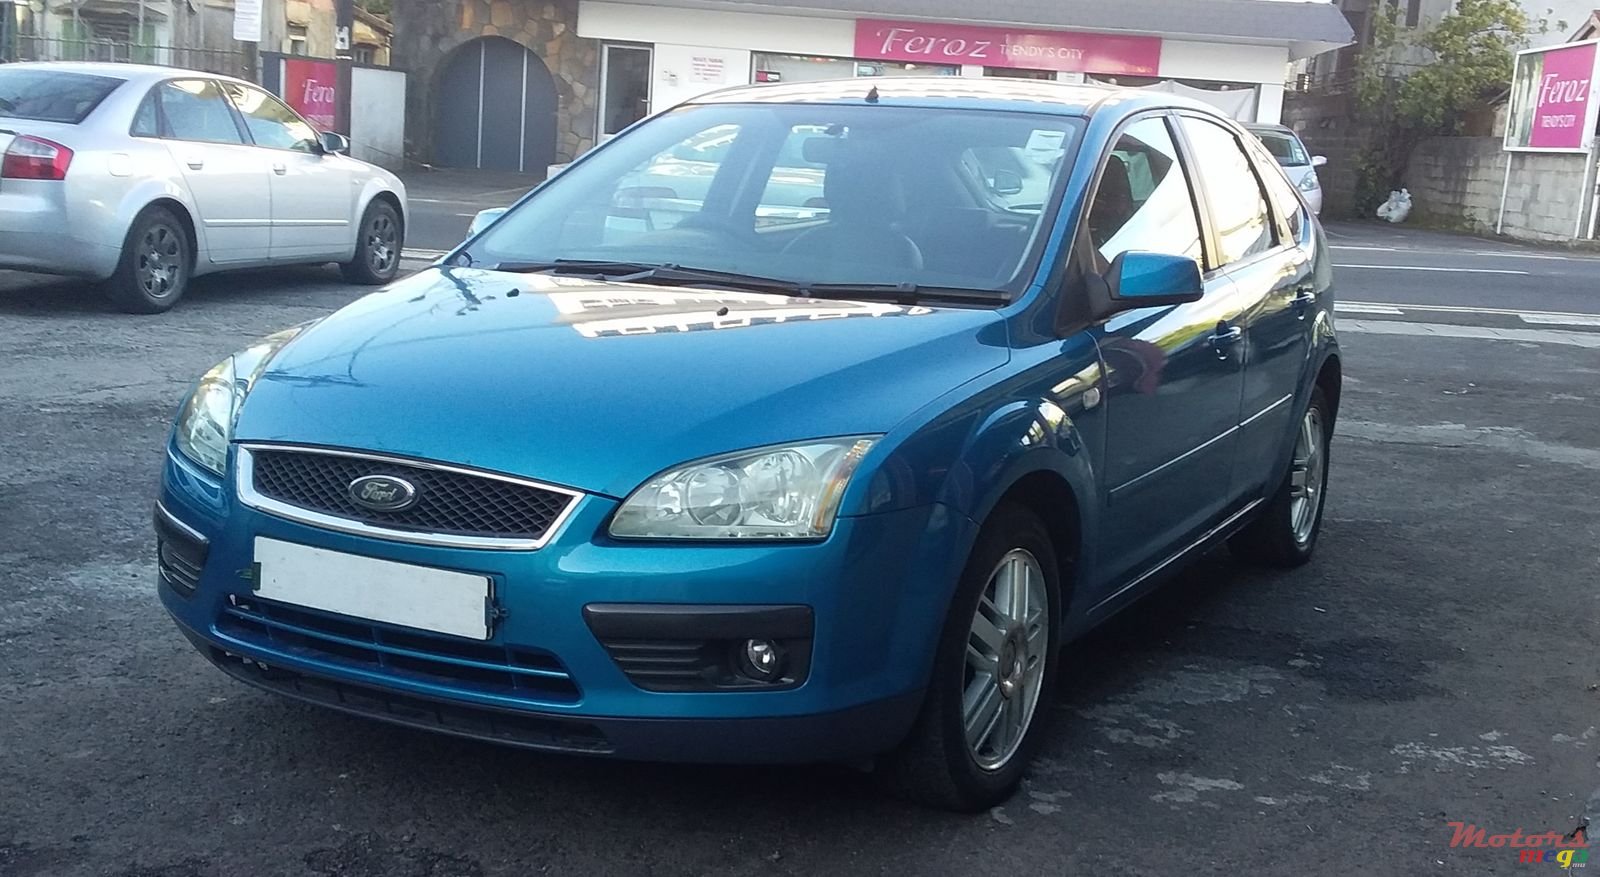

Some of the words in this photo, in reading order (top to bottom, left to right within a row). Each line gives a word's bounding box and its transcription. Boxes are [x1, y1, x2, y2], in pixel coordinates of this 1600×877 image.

[877, 27, 991, 58] Feroz
[999, 43, 1056, 58] TENDY'S
[1057, 47, 1084, 60] CITY
[302, 78, 335, 104] Fero
[1538, 73, 1589, 108] Feroz
[361, 481, 398, 501] Ford
